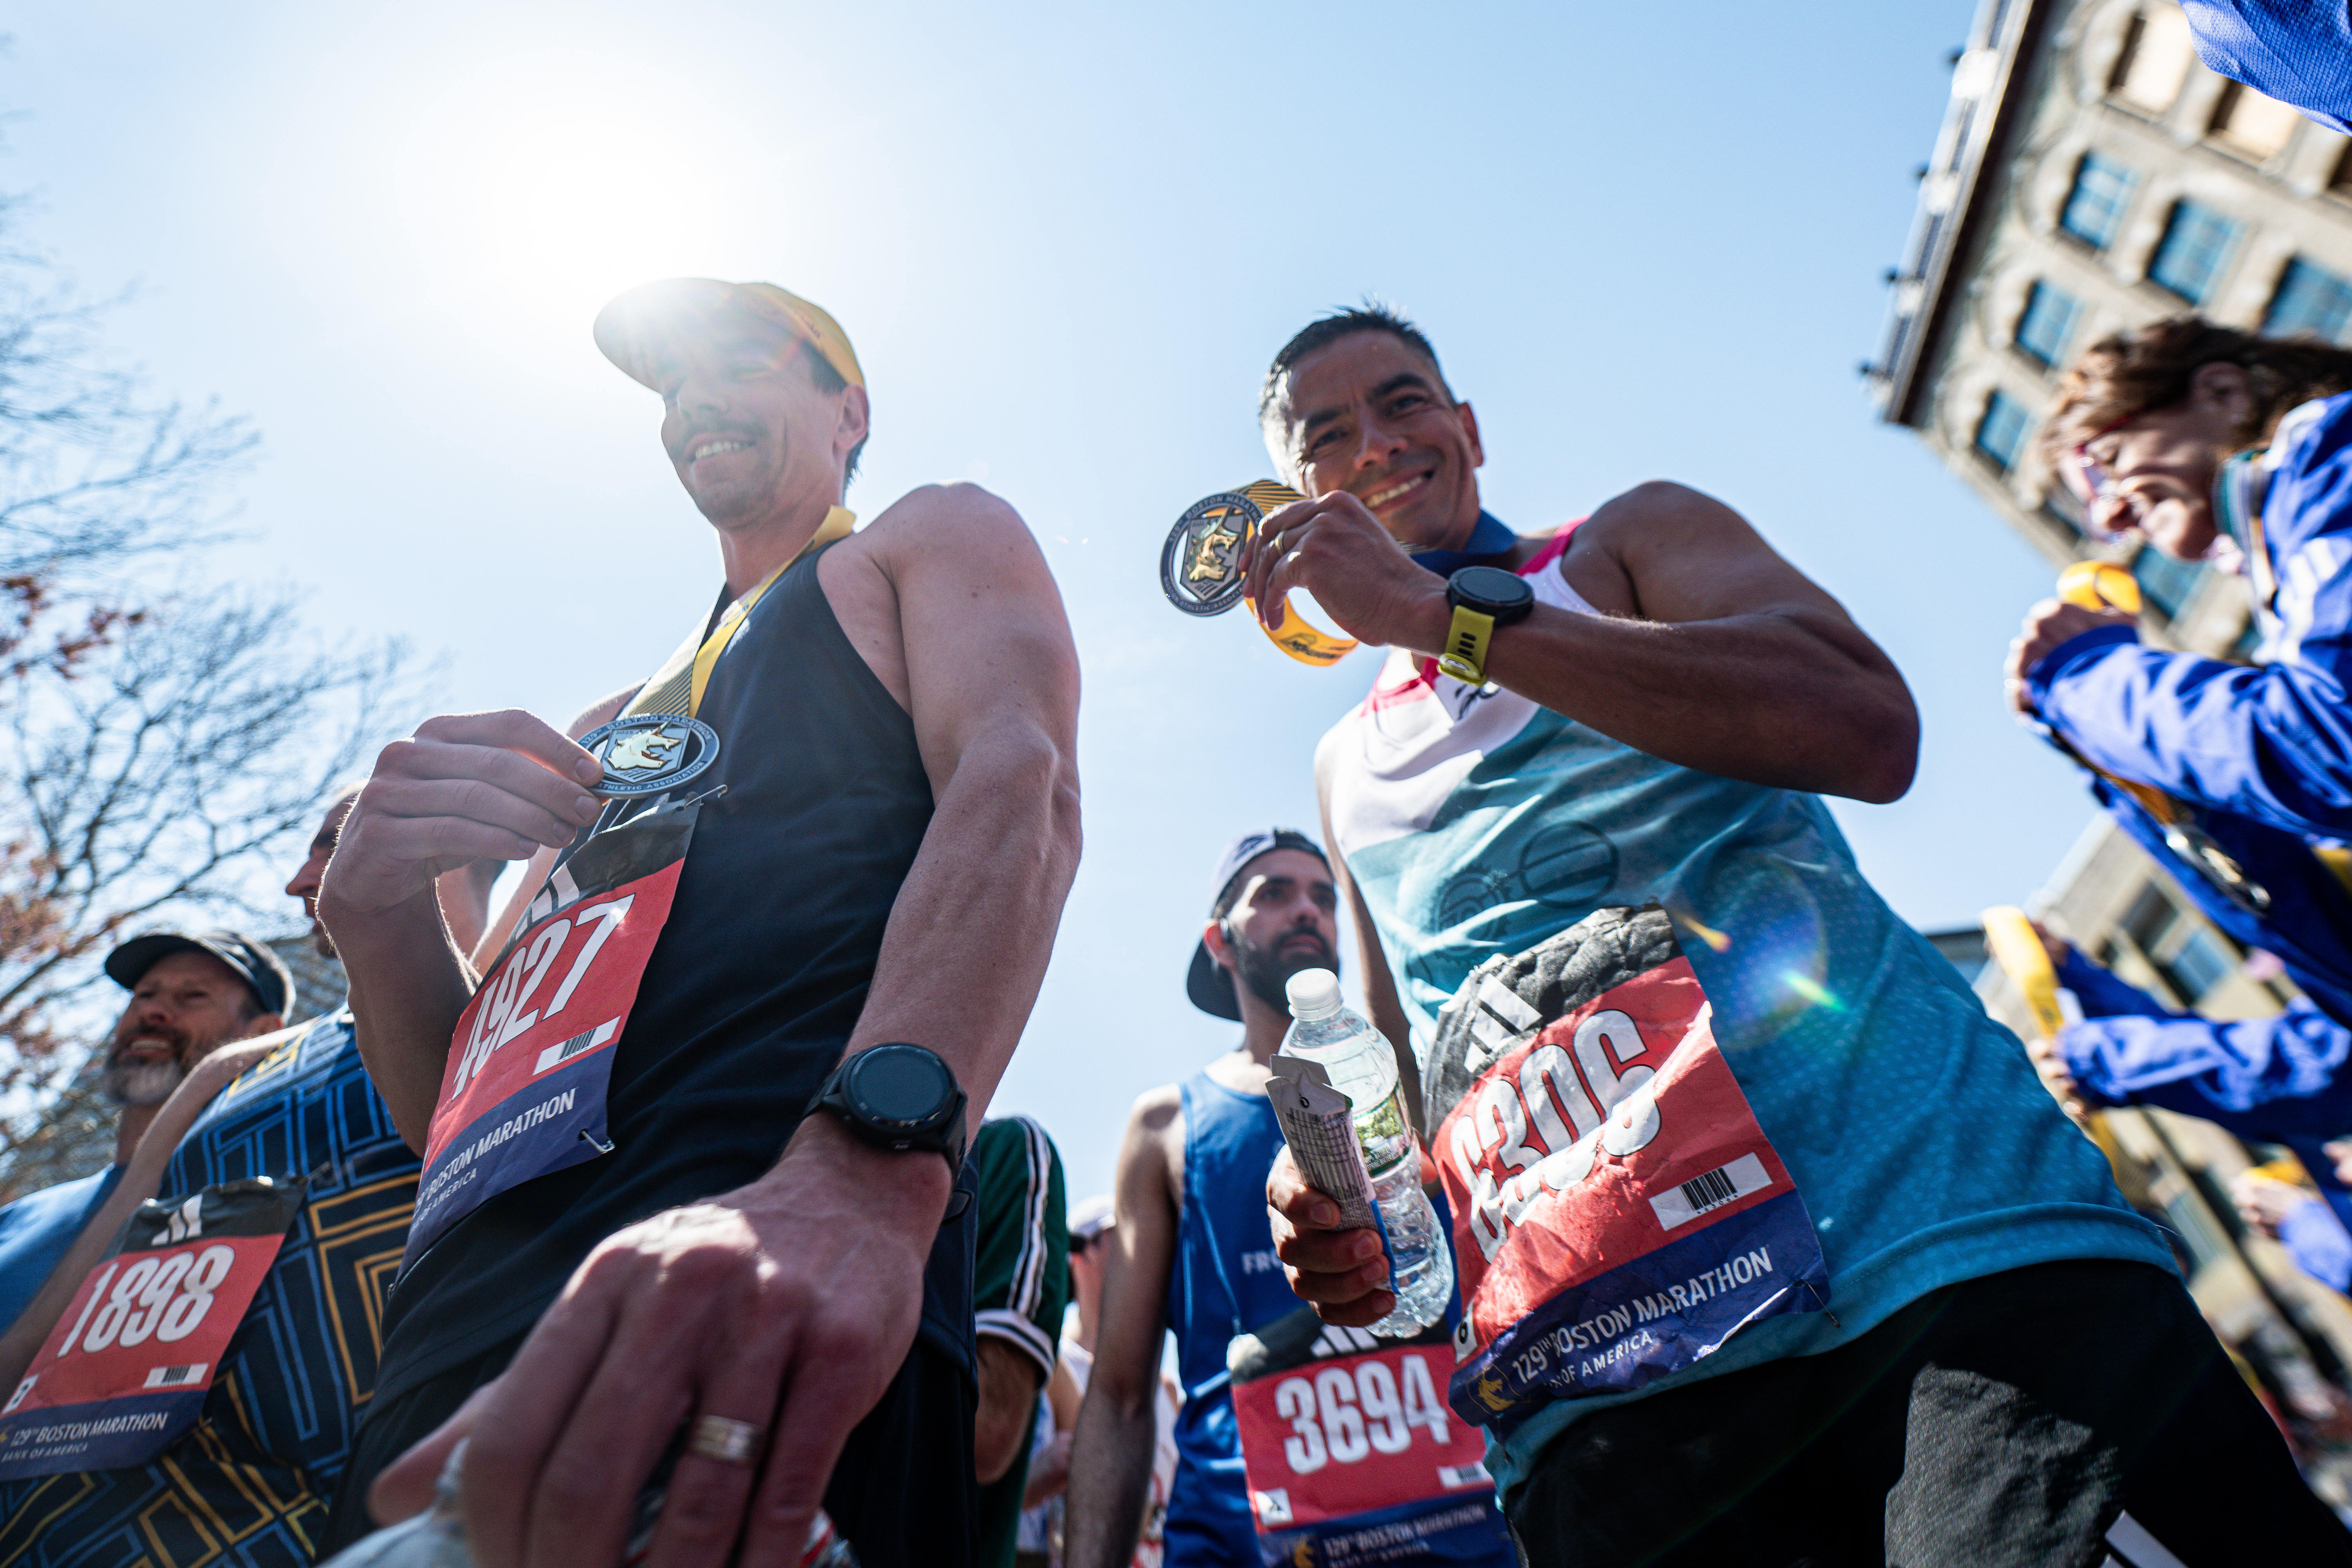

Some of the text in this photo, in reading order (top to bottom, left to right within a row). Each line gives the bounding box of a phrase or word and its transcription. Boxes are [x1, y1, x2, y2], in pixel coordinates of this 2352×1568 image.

[1225, 495, 1259, 523] MARATHO
[1181, 601, 1212, 611] ATHLETIC
[608, 716, 658, 730] BOSTON
[661, 716, 713, 740] MARATHON
[647, 761, 706, 789] ASSOCIATION
[451, 893, 635, 1101] 4927
[426, 1143, 475, 1201] BOSTON
[475, 1088, 576, 1159] MARATHON
[1450, 1009, 1661, 1264] 6306
[430, 1168, 477, 1211] AMERICA
[57, 1244, 236, 1357] 1898
[1512, 1247, 1773, 1384] 129TH BOSTON MARATHON
[1561, 1364, 1575, 1384] OF
[1582, 1330, 1653, 1377] AMERICA
[35, 1421, 91, 1443] BOSTON
[90, 1411, 169, 1437] MARATHON
[1274, 1354, 1452, 1475] 3694
